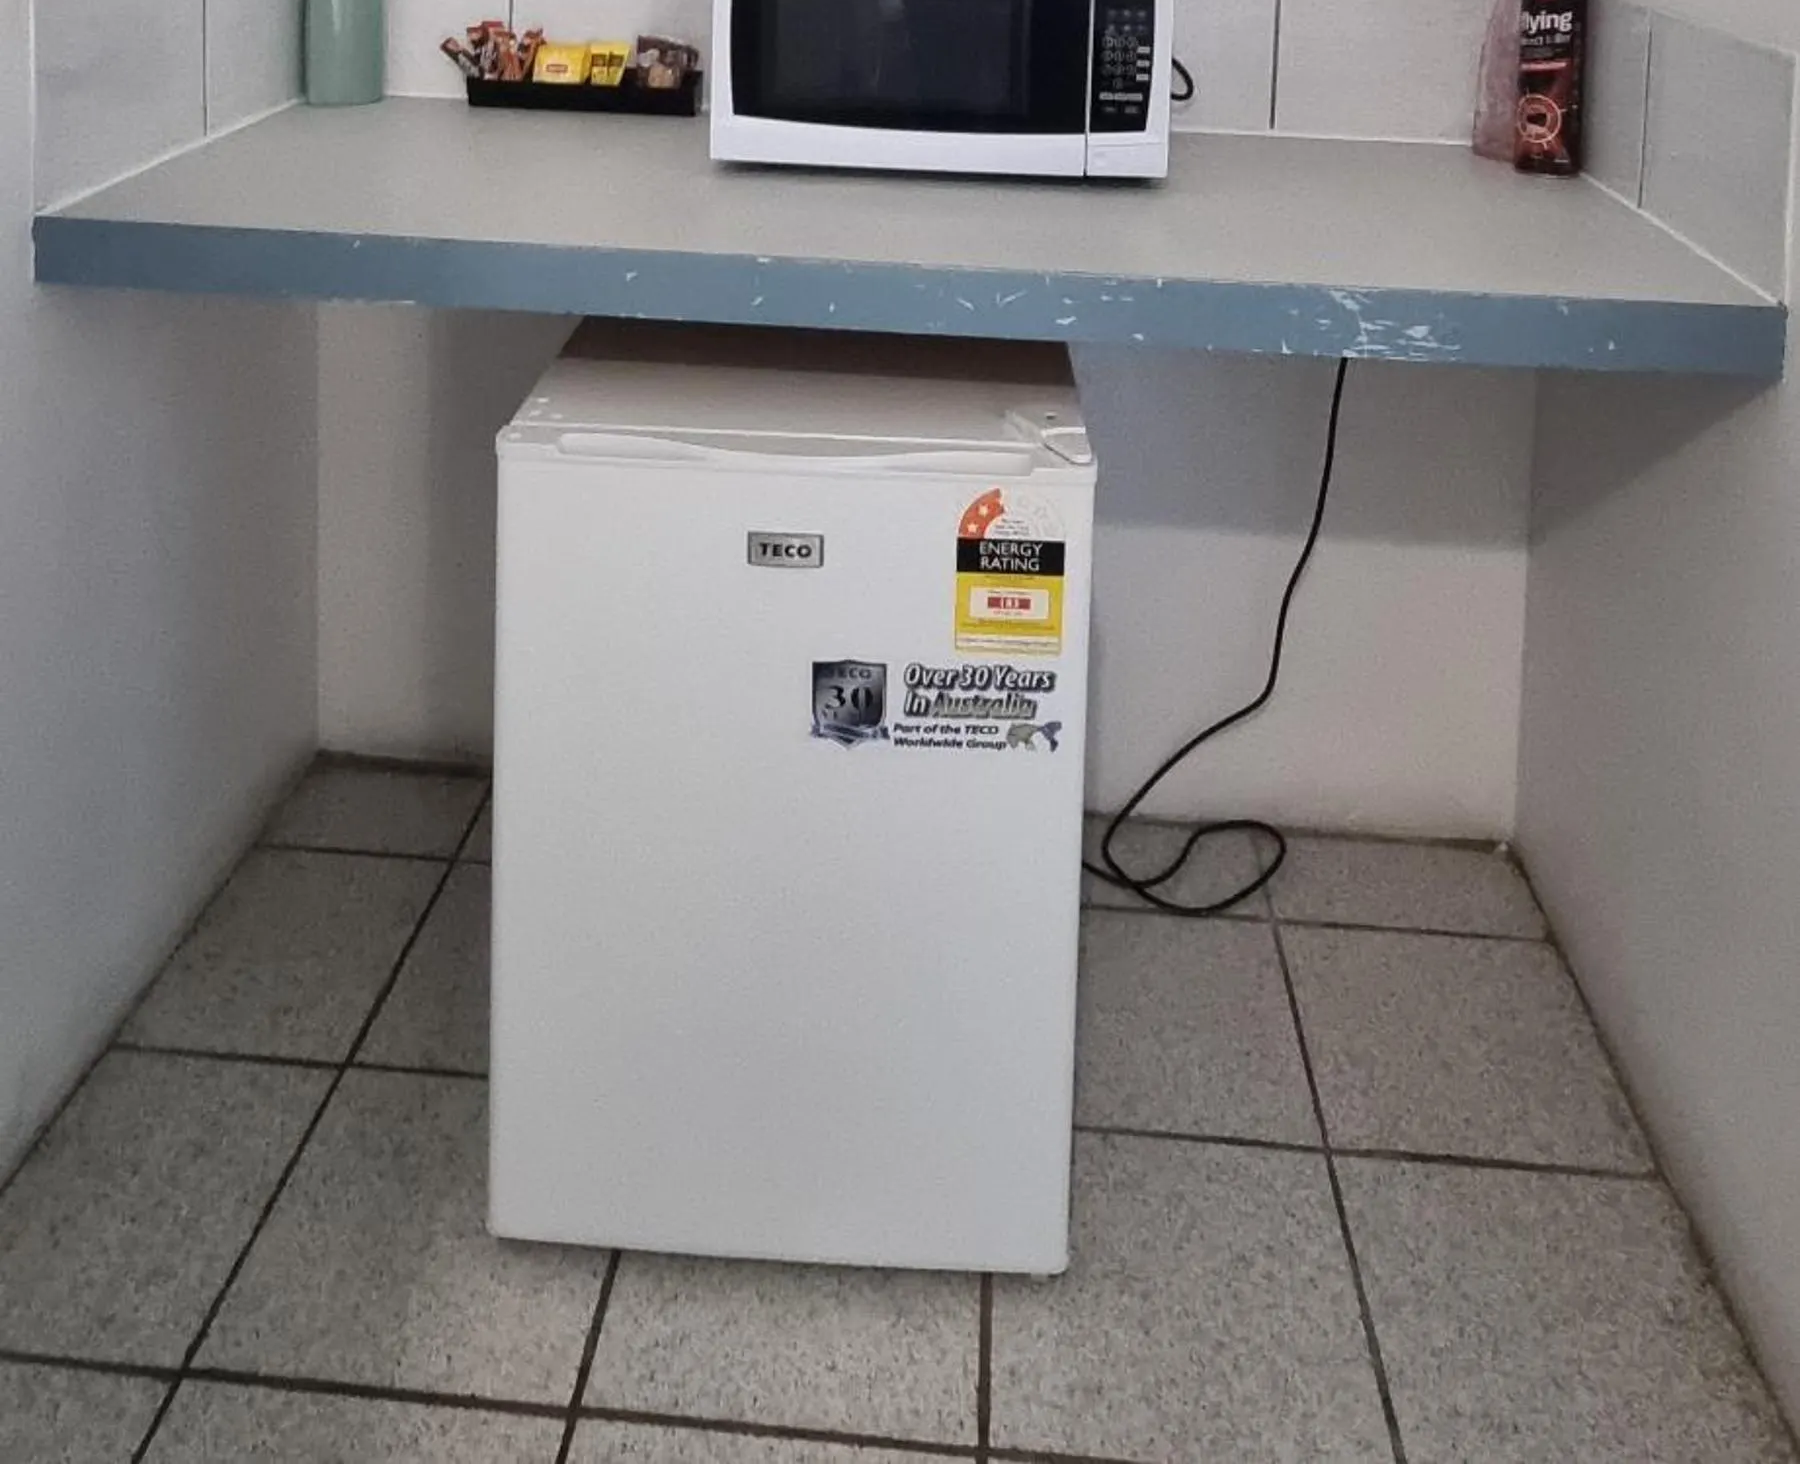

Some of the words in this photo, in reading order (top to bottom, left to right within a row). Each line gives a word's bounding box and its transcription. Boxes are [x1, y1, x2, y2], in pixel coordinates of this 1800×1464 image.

[759, 543, 812, 558] TECO
[979, 541, 1044, 557] ENERGY
[980, 557, 1041, 572] RATING
[904, 663, 957, 688] Over
[960, 665, 991, 689] 30
[993, 665, 1054, 691] Years
[825, 685, 874, 710] 30
[904, 689, 931, 717] In
[932, 691, 1037, 719] Australia
[893, 723, 921, 733] Part
[926, 722, 938, 733] of
[939, 723, 961, 734] the
[964, 725, 998, 735] TECO
[966, 739, 1007, 751] Group
